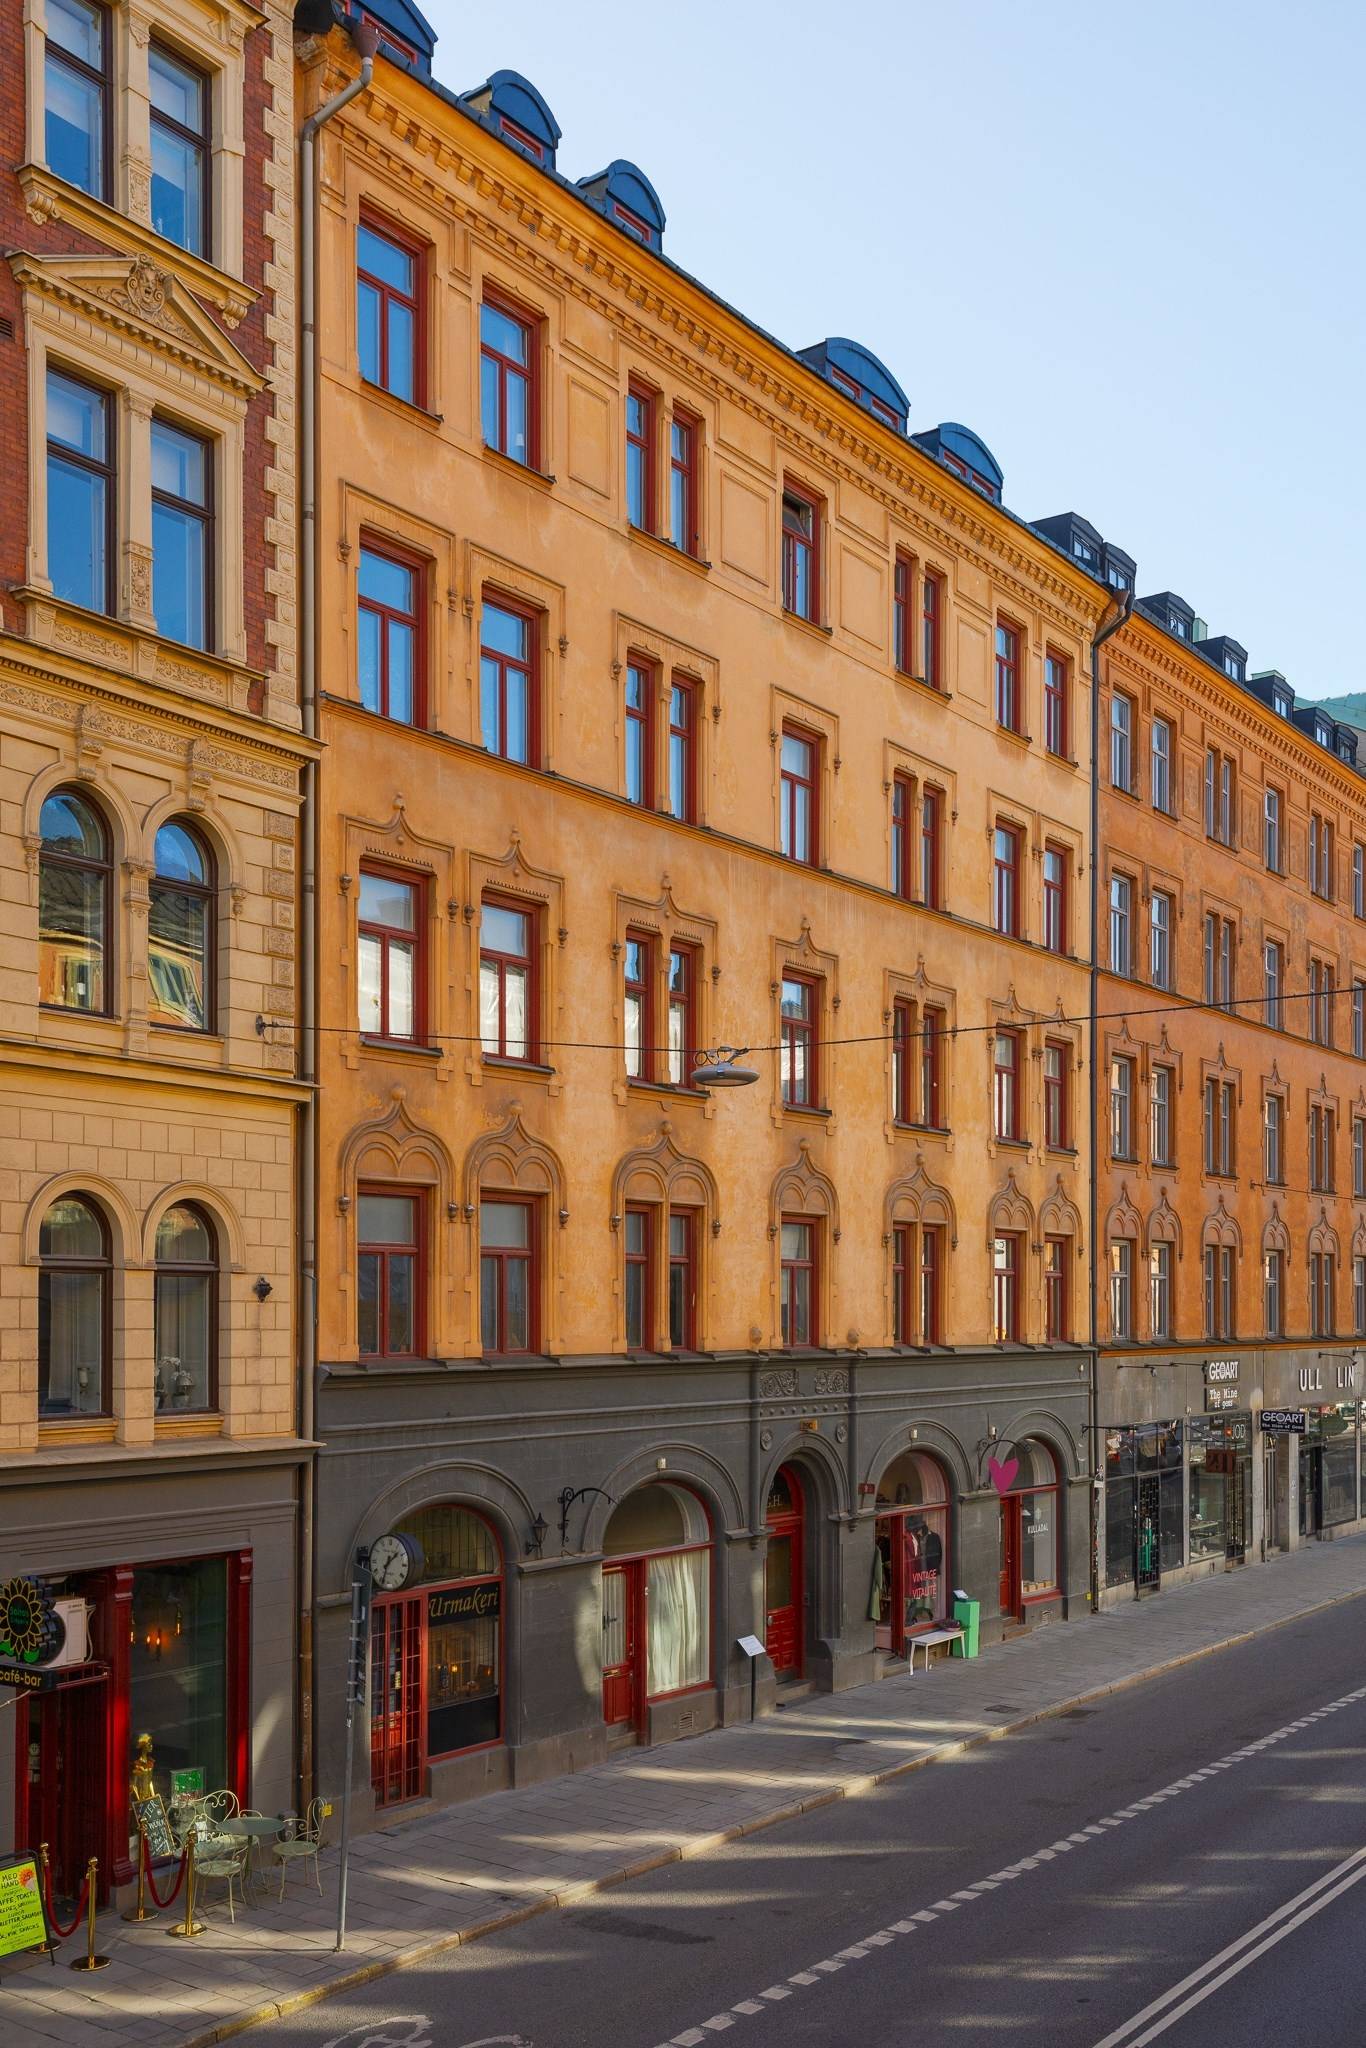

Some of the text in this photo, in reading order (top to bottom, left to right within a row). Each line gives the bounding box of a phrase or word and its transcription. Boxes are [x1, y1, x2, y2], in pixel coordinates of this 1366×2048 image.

[1209, 1361, 1238, 1380] GEOART
[1300, 1368, 1322, 1392] ULL
[1209, 1387, 1238, 1400] The Mine
[1262, 1412, 1304, 1423] GEOART
[912, 1568, 937, 1583] VINTAGE
[428, 1587, 498, 1618] Urmakeri
[0, 1669, 42, 1687] café-bar
